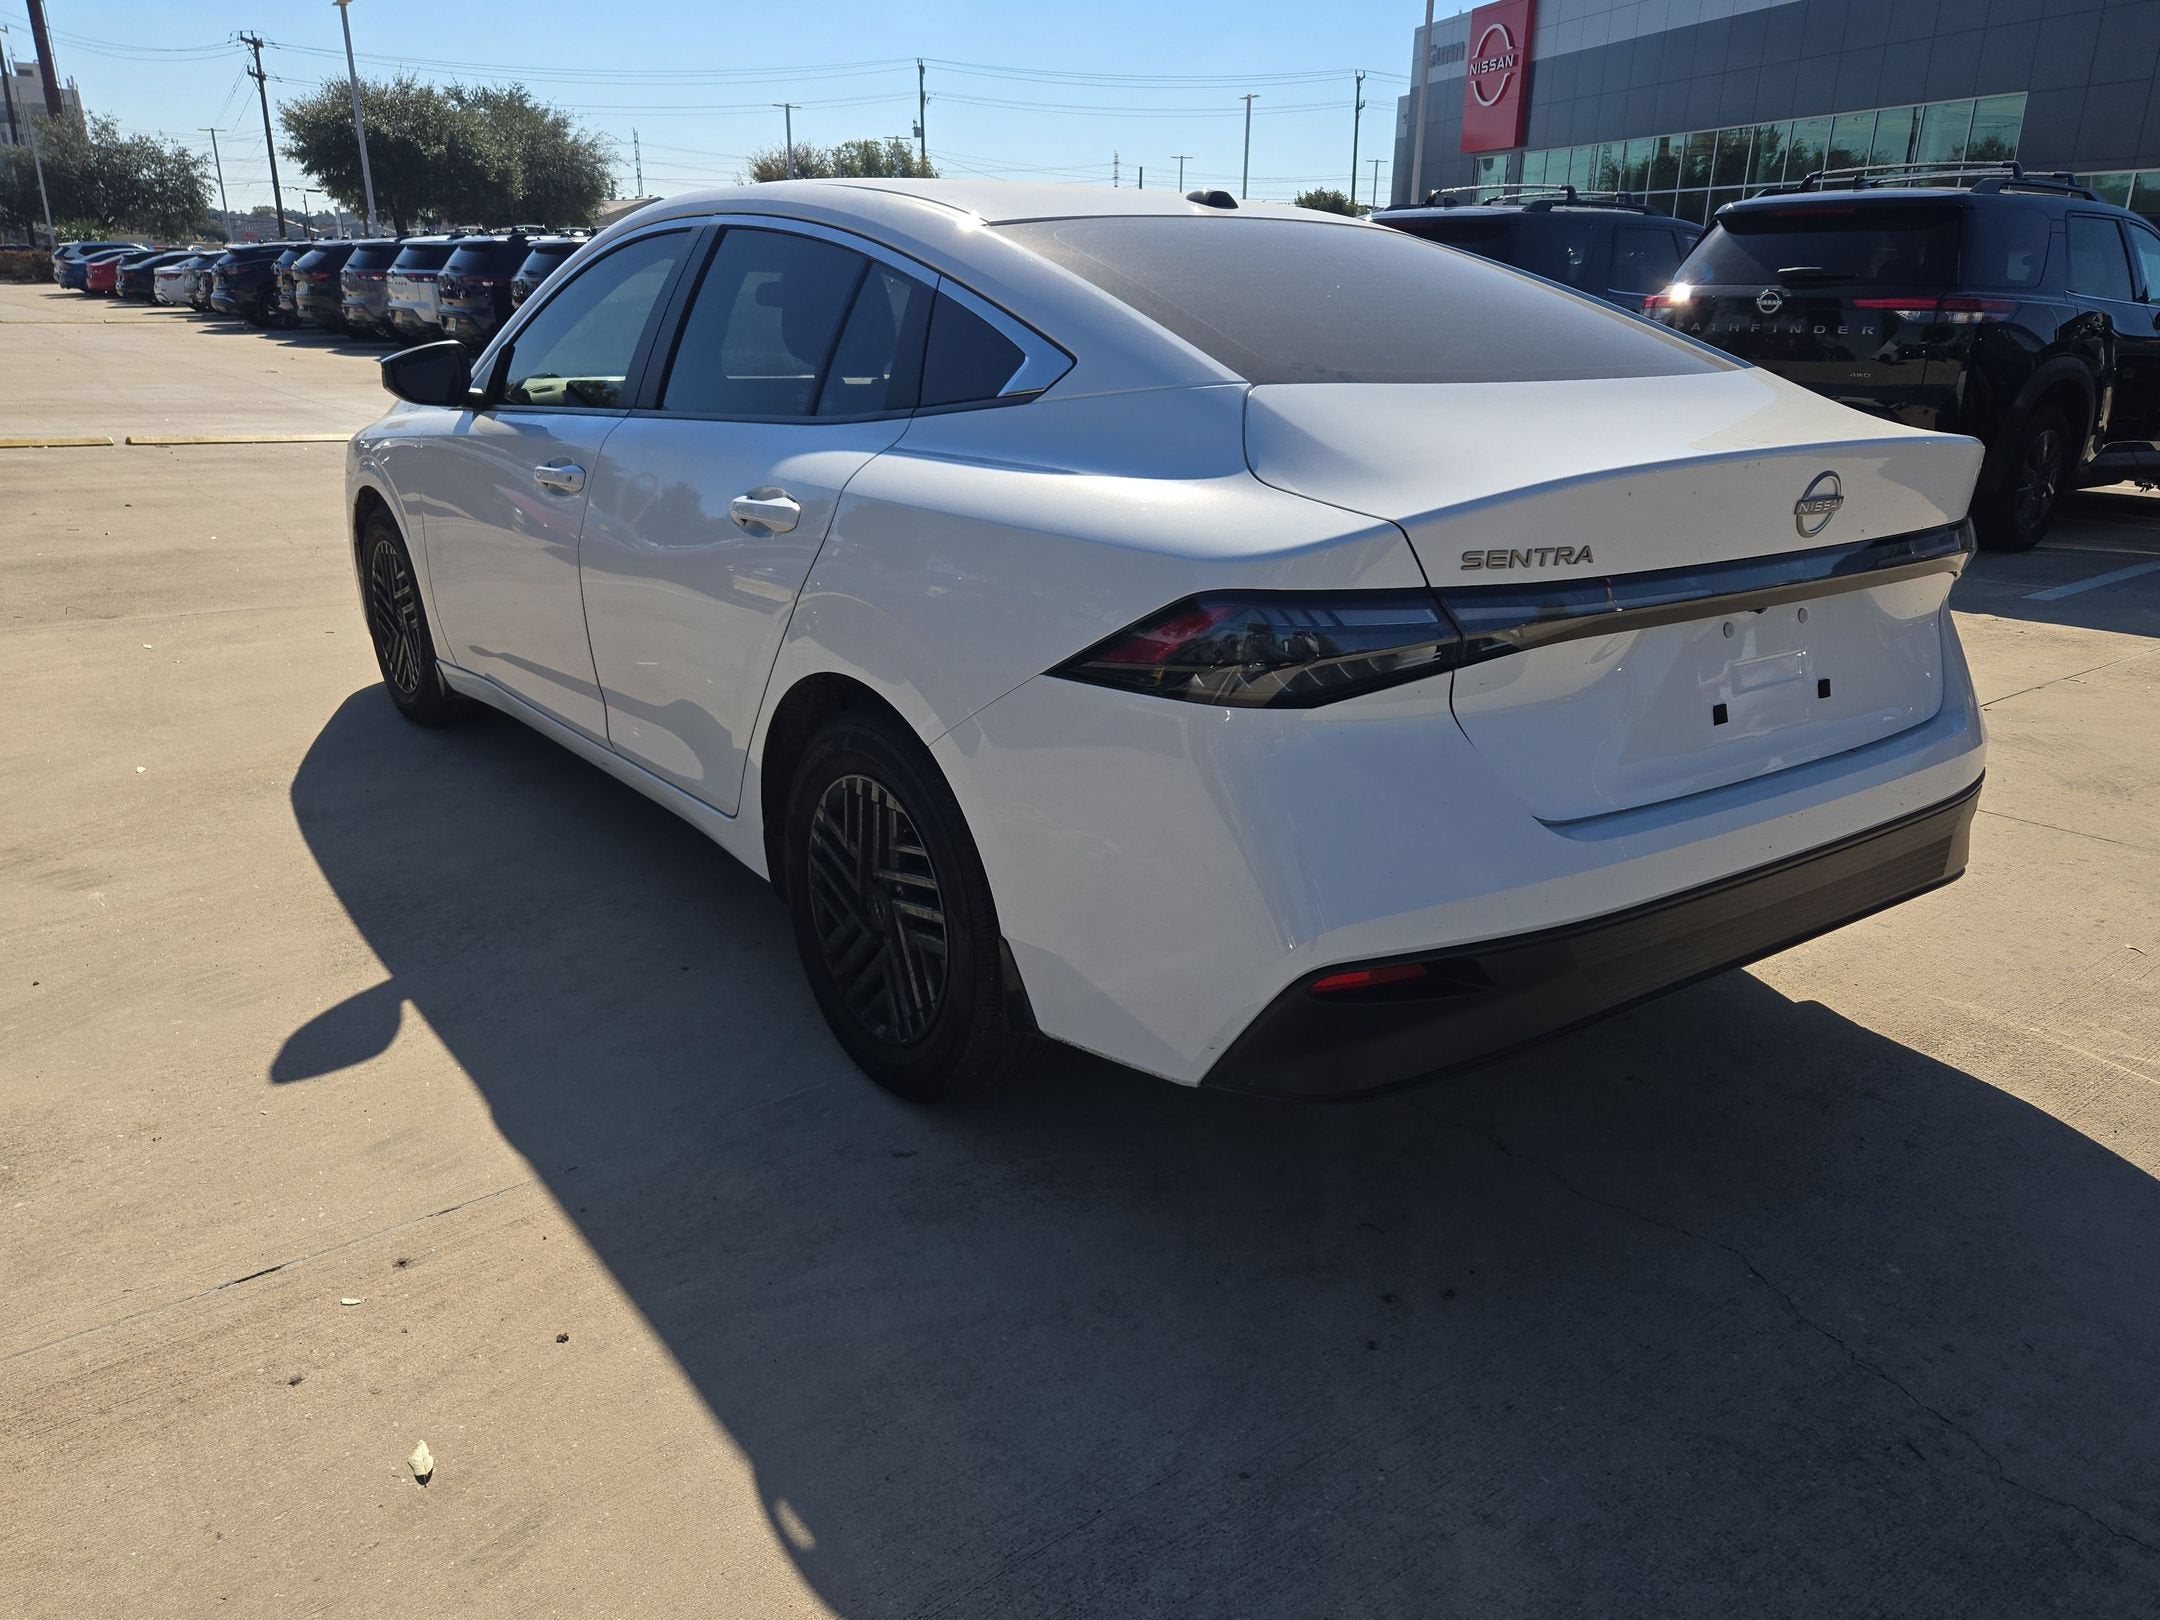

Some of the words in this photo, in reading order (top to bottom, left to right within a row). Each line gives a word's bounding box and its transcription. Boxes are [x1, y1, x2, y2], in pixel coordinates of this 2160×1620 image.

[1469, 54, 1514, 76] NISSAN
[1674, 322, 1875, 335] PATHFINDER
[1799, 498, 1844, 513] NISSAN
[1460, 545, 1594, 571] SENTRA
